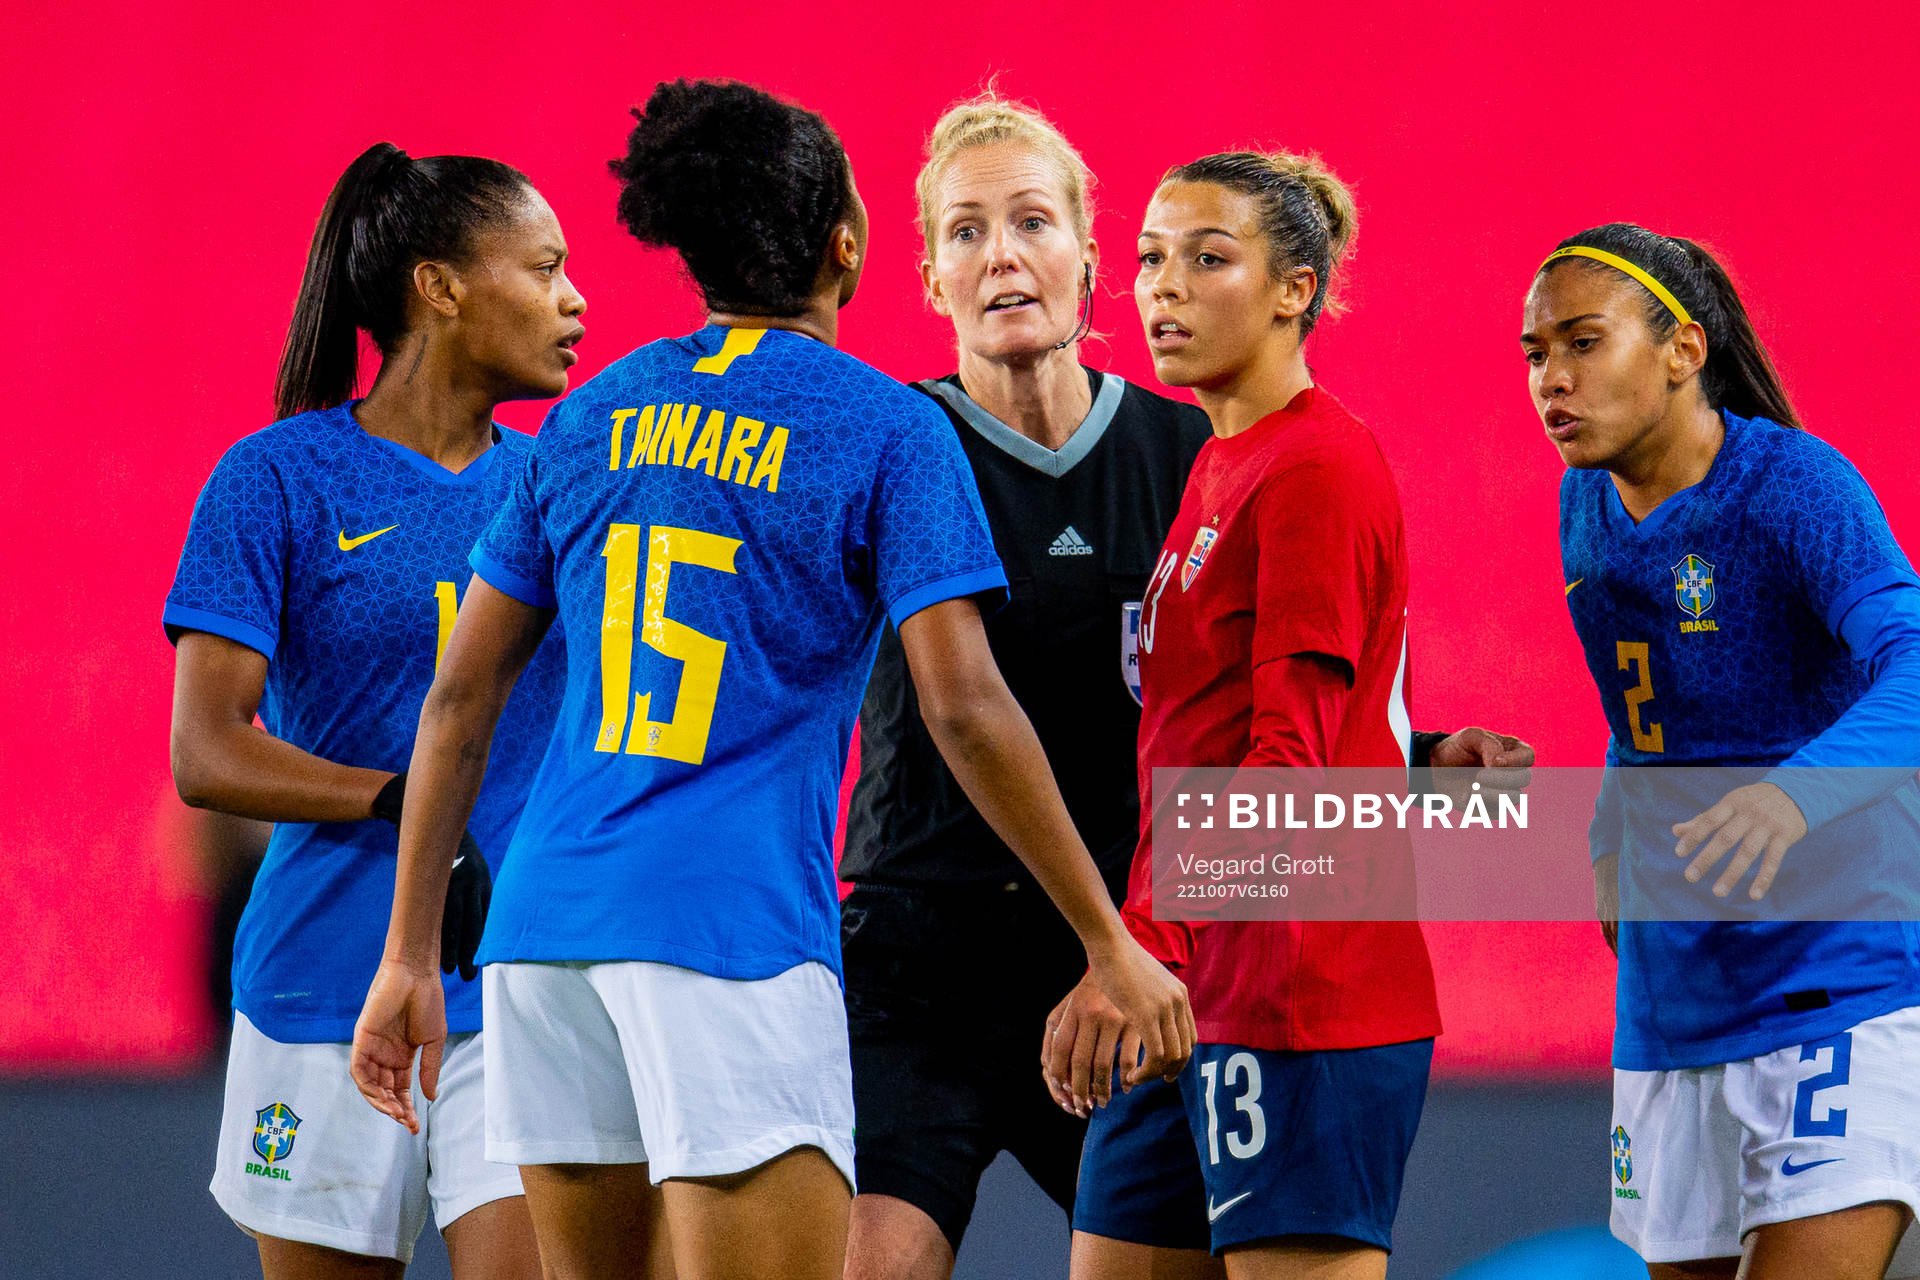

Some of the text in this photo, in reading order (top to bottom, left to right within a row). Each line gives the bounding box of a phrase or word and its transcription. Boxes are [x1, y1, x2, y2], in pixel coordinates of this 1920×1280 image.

[610, 403, 789, 493] TAINARA
[1049, 544, 1093, 556] adidas
[1686, 579, 1703, 589] CBF
[594, 523, 744, 766] 15
[1679, 619, 1720, 634] BRASIL
[1616, 640, 1665, 753] 2
[1201, 1052, 1267, 1165] 13
[1793, 1032, 1852, 1138] 2
[267, 1126, 284, 1136] CBF
[245, 1161, 292, 1181] BRASIL
